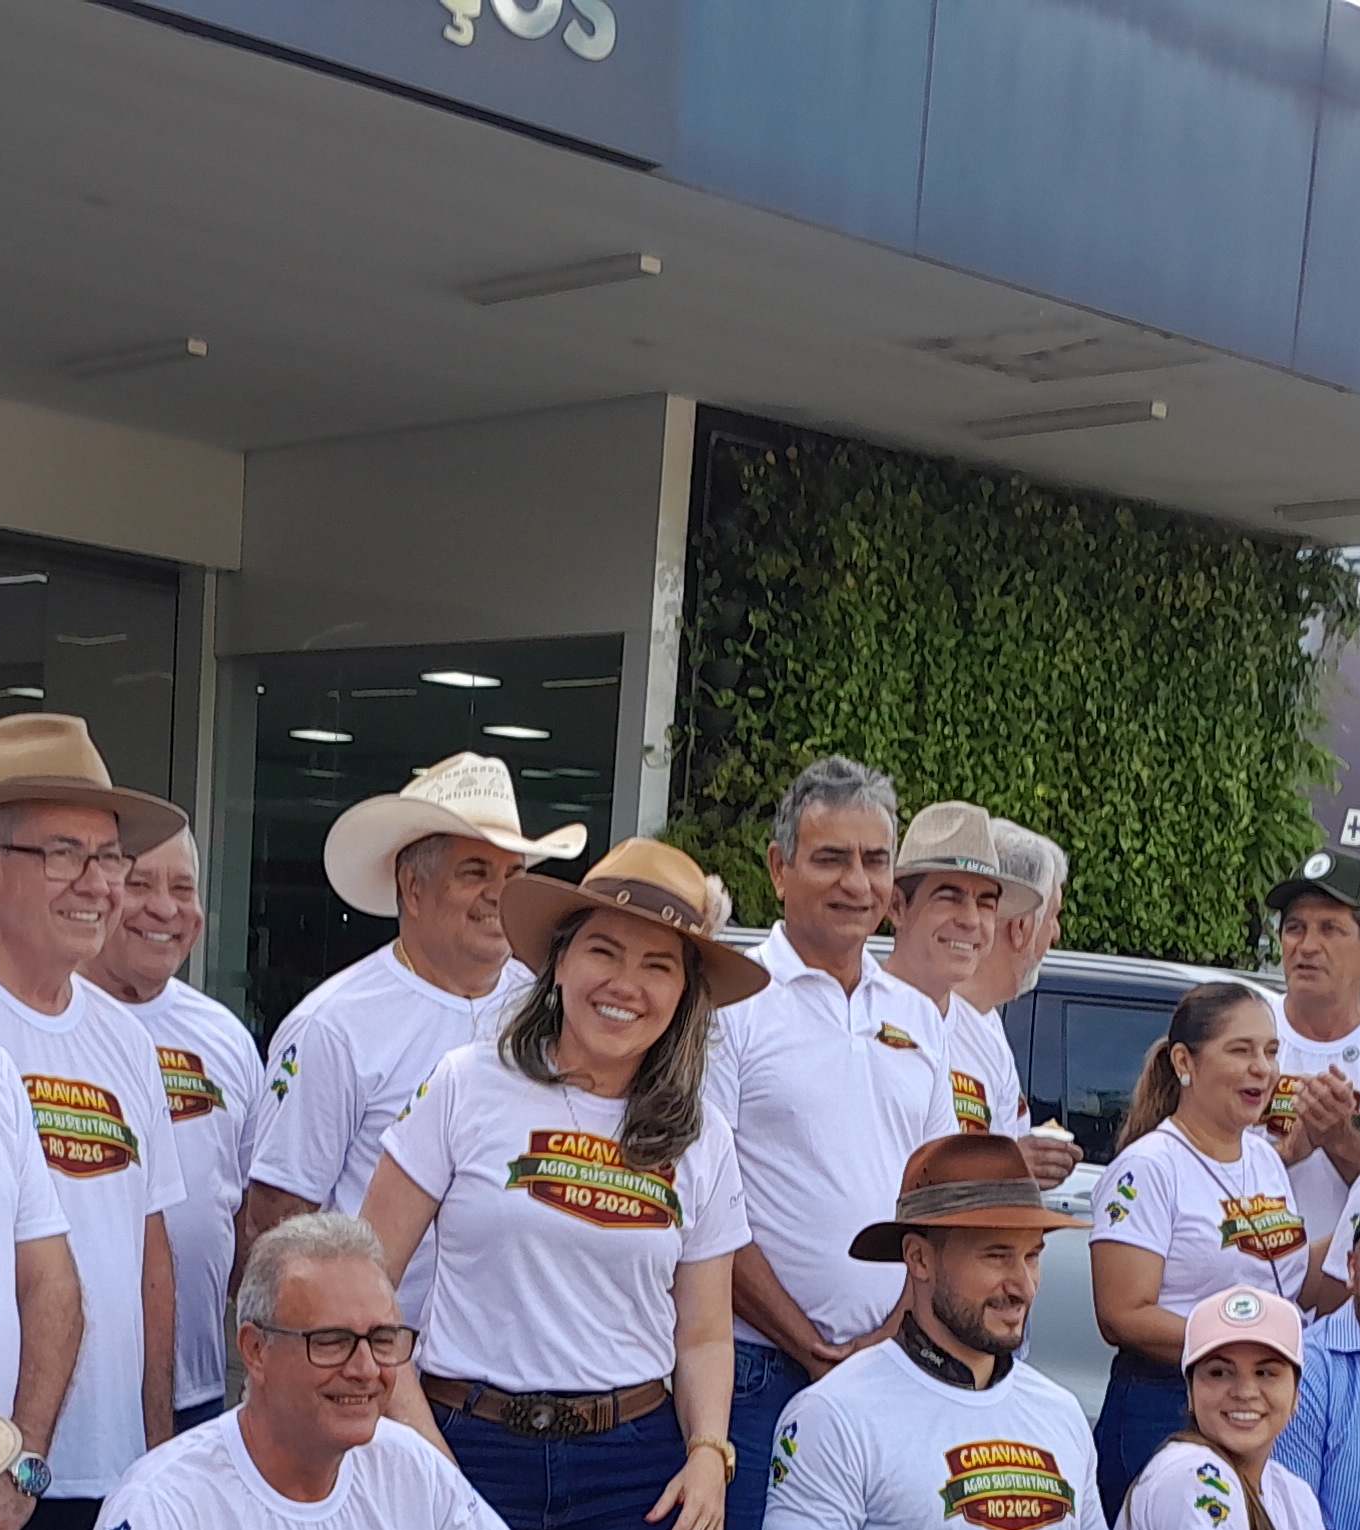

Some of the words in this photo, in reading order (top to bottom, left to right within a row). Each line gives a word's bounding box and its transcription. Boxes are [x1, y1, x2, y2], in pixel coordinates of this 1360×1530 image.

[547, 1134, 621, 1166] CARAV
[537, 1159, 578, 1178] AGRO
[579, 1168, 669, 1204] SUSTENTÁVEL
[563, 1185, 593, 1208] RO
[595, 1191, 642, 1218] 2026
[960, 1444, 1047, 1469] CARAVANA
[963, 1475, 991, 1496] AGRO
[987, 1499, 1005, 1518] RO
[1006, 1499, 1041, 1518] 2026
